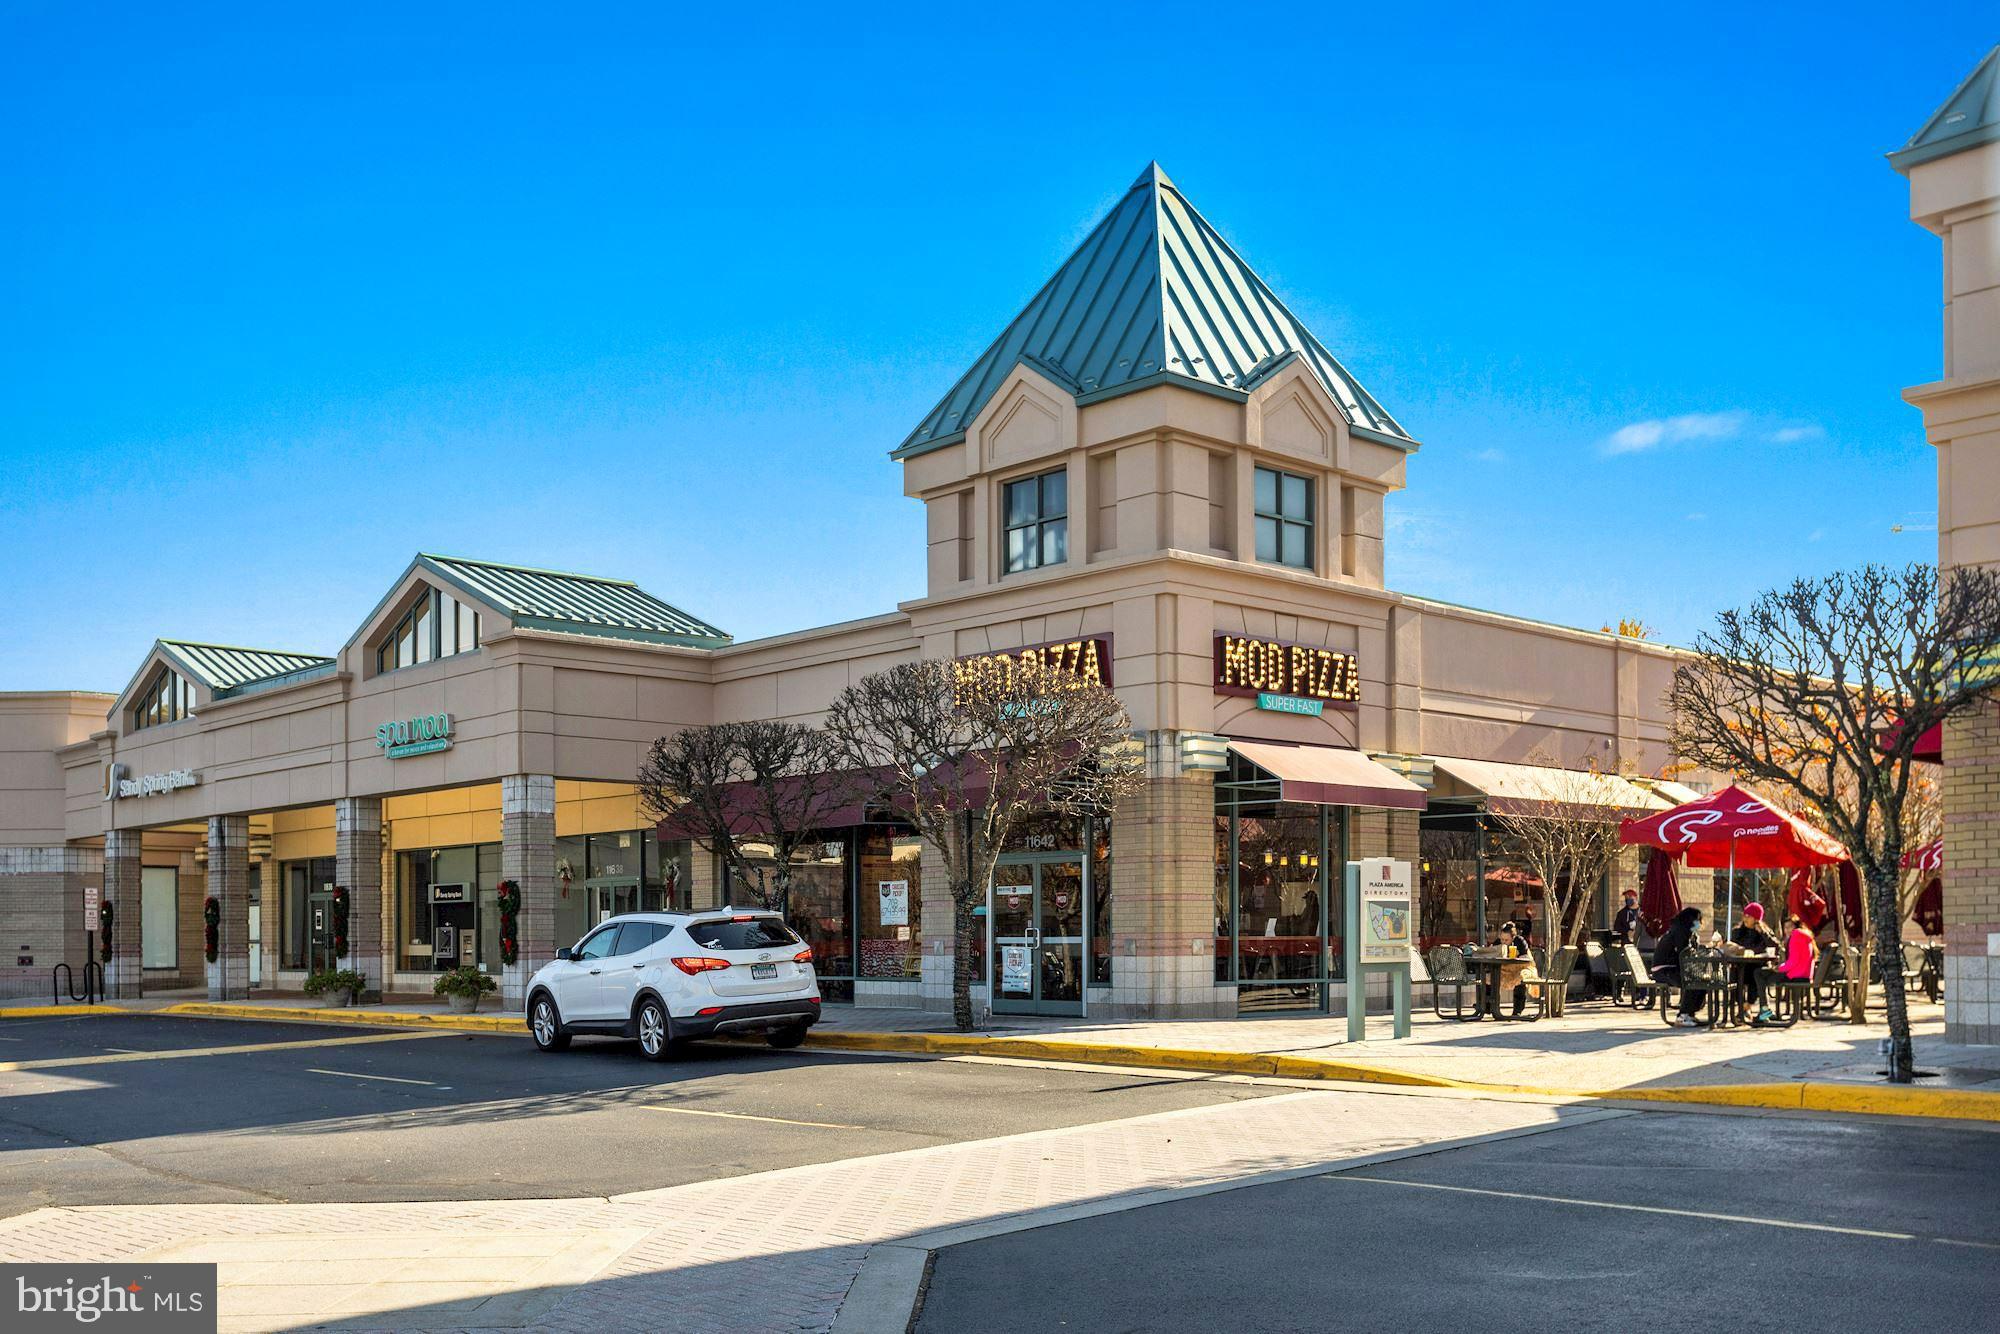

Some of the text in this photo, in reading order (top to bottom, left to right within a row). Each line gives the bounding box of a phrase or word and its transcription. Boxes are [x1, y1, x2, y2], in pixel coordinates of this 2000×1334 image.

[1225, 635, 1360, 701] MOD PIZZA
[1265, 695, 1319, 714] SUPER FAST
[376, 712, 448, 759] spa noa
[120, 768, 194, 798] Sandy Spring Bank
[1747, 825, 1779, 835] noodles
[1025, 834, 1055, 848] 11642
[606, 864, 624, 875] 11638
